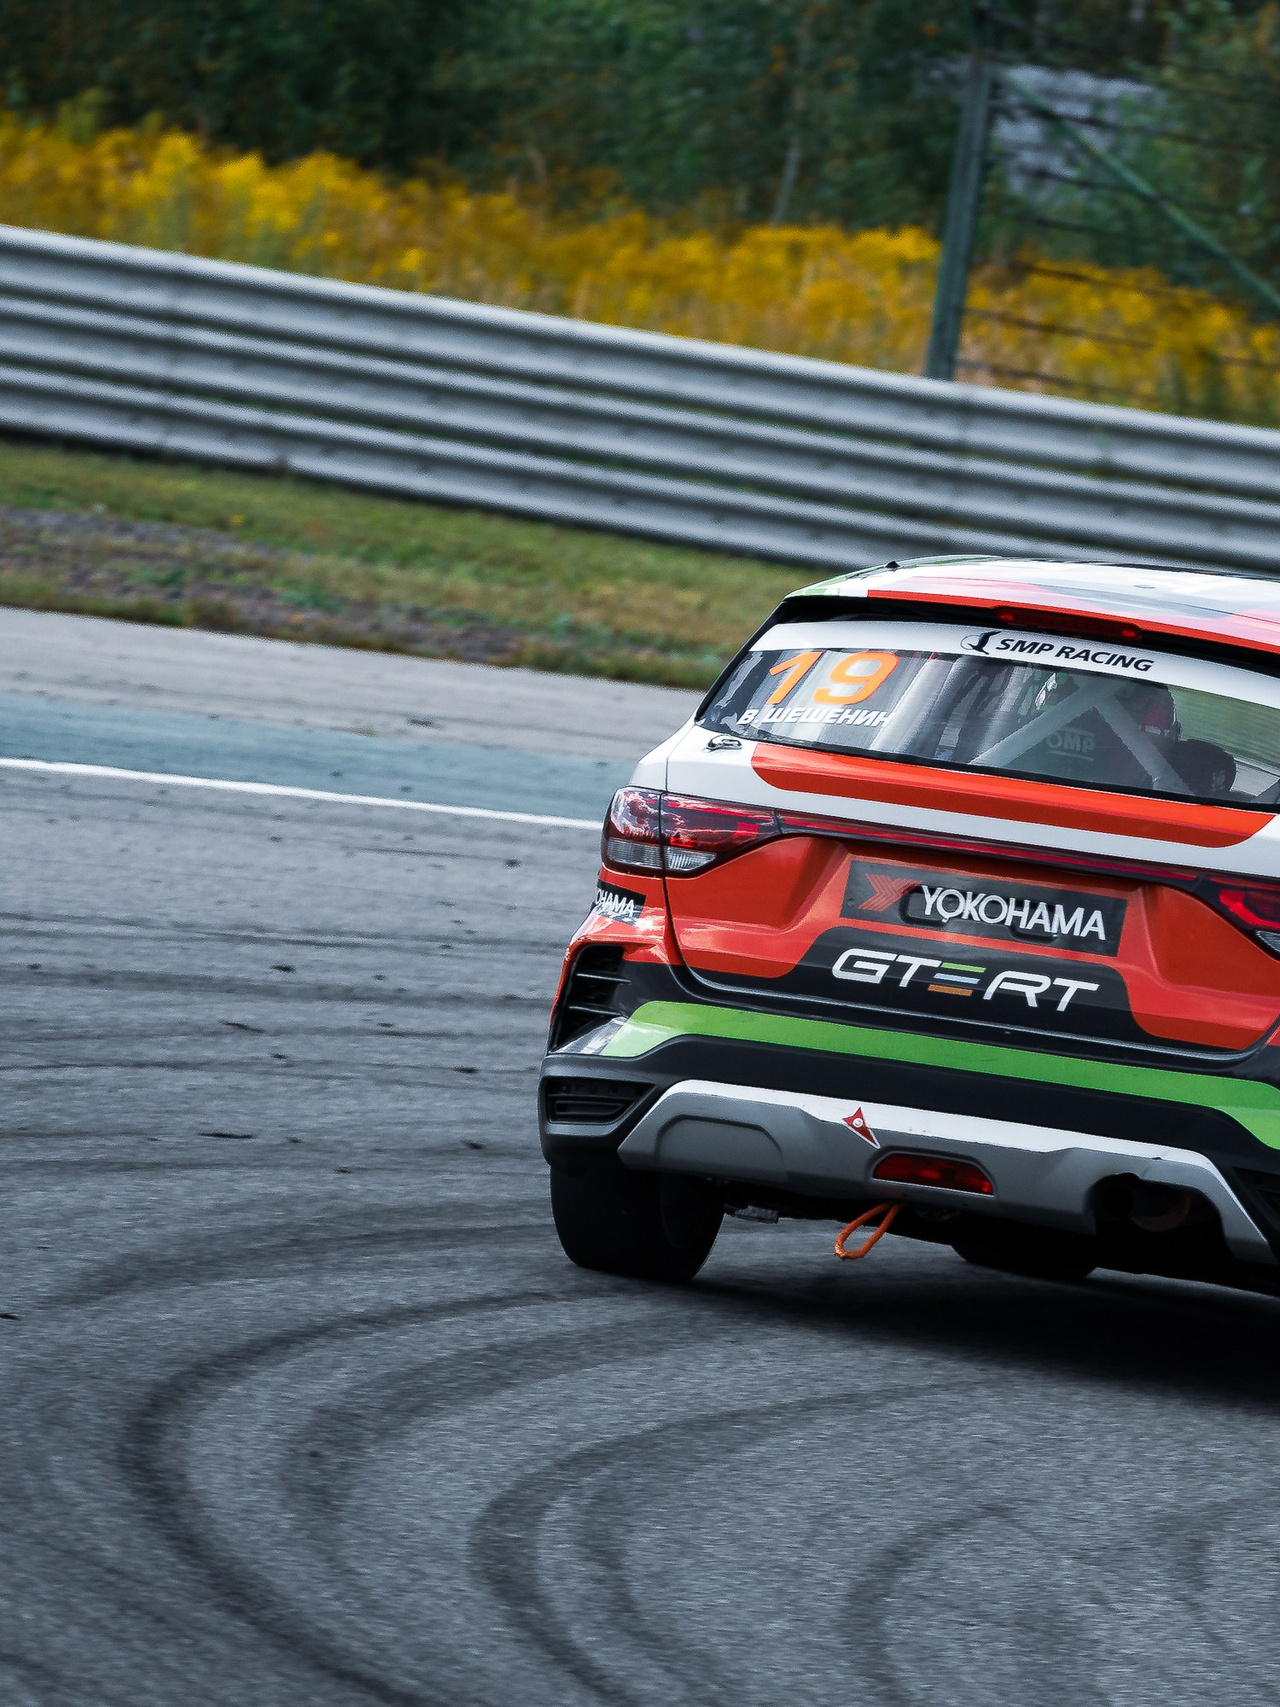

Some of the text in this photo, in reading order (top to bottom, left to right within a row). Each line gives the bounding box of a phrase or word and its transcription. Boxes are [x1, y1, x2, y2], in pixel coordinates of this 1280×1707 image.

[996, 638, 1155, 672] SMP RACING
[769, 651, 899, 706] 19
[1049, 729, 1096, 753] OMP
[921, 884, 1108, 941] YOKOHAMA
